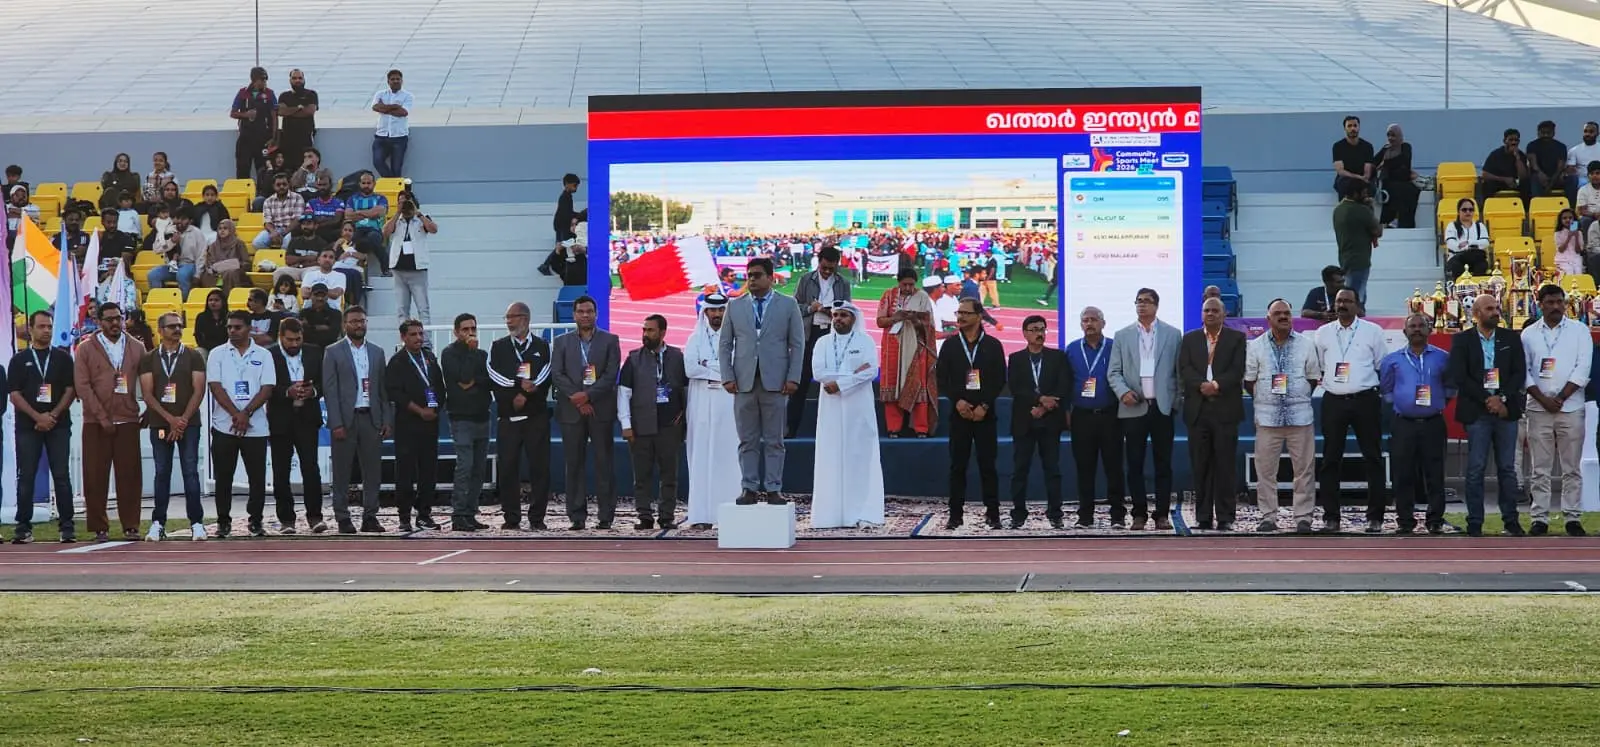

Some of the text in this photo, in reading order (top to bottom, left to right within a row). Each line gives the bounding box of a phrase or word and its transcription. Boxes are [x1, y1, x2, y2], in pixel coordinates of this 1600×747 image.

[985, 108, 1076, 129] ഖത്തർ
[1082, 107, 1177, 132] ഇന്ത്യൻ
[1115, 150, 1157, 158] Community
[1115, 157, 1138, 165] Sports
